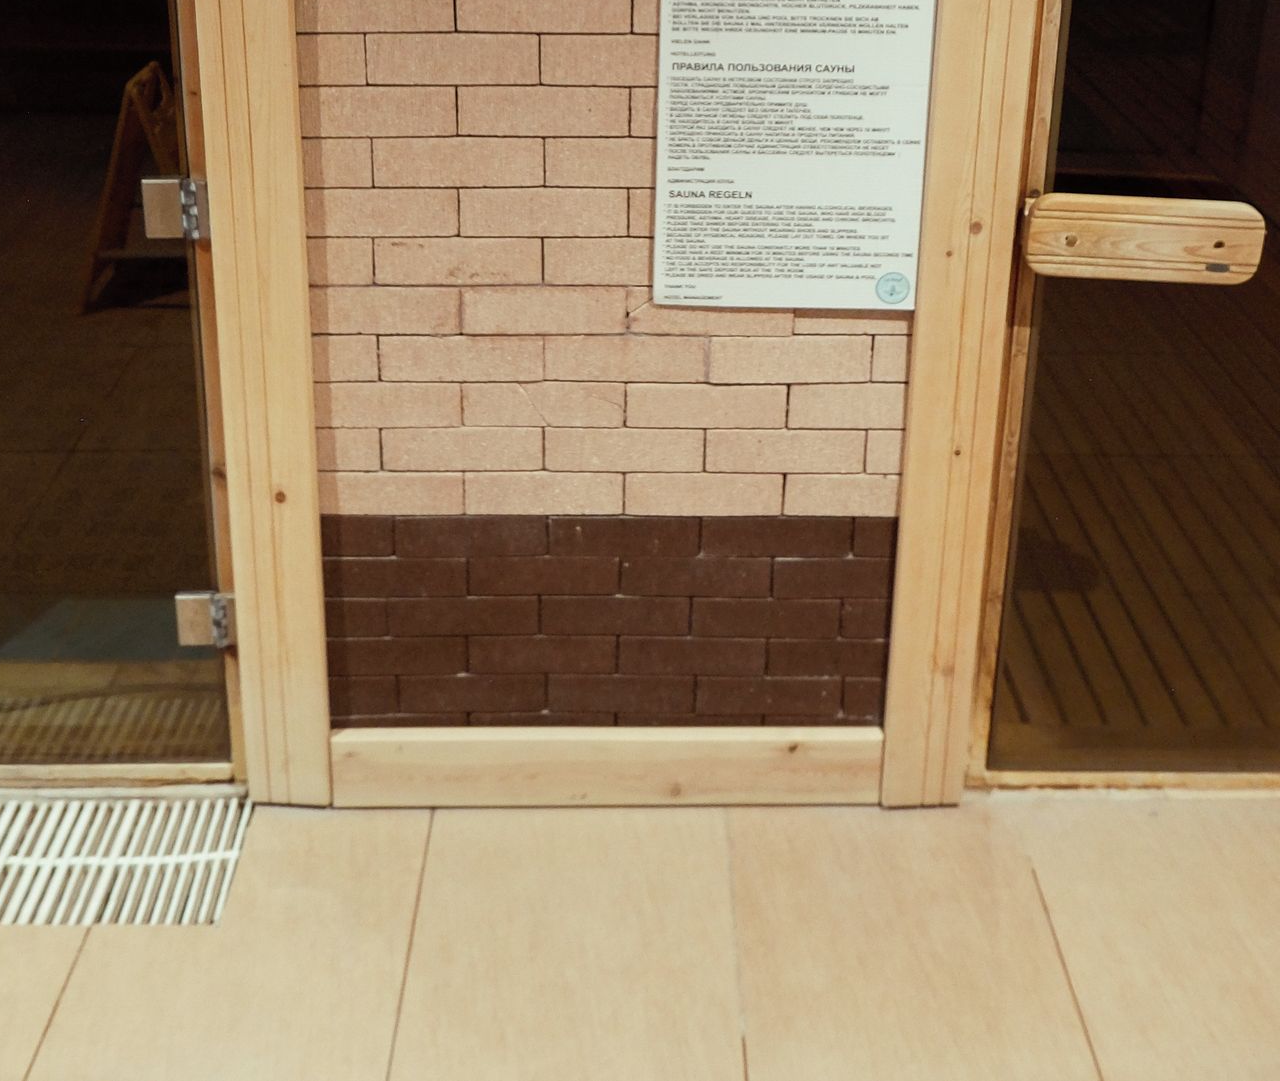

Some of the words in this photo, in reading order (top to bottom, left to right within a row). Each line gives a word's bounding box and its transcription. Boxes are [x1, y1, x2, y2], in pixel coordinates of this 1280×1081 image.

[672, 62, 724, 72] ПРАВИЛА
[727, 63, 812, 73] ПОЛЬЗОВАНИЯ
[815, 64, 855, 74] САУНЫ
[668, 190, 706, 199] SAUNA
[708, 190, 753, 200] REGELN
